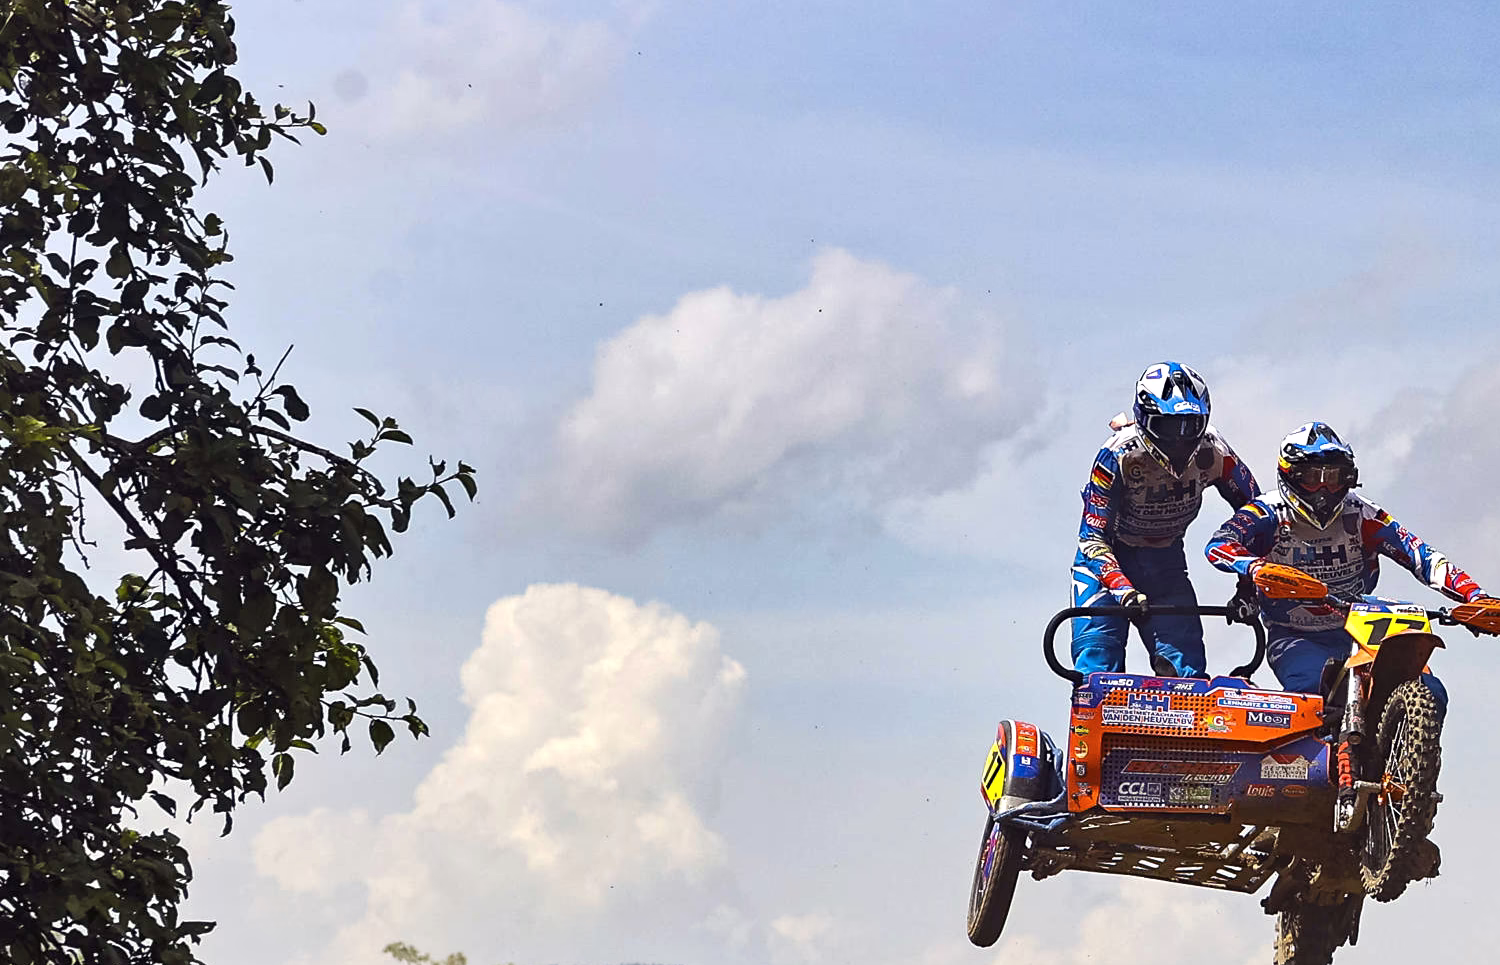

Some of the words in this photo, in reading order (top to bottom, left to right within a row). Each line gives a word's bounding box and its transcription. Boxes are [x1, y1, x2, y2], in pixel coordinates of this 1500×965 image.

[1223, 699, 1261, 708] LENNARTZ
[1143, 716, 1179, 724] HEUVEL
[1119, 782, 1147, 795] CCL
[1247, 784, 1275, 797] Louis
